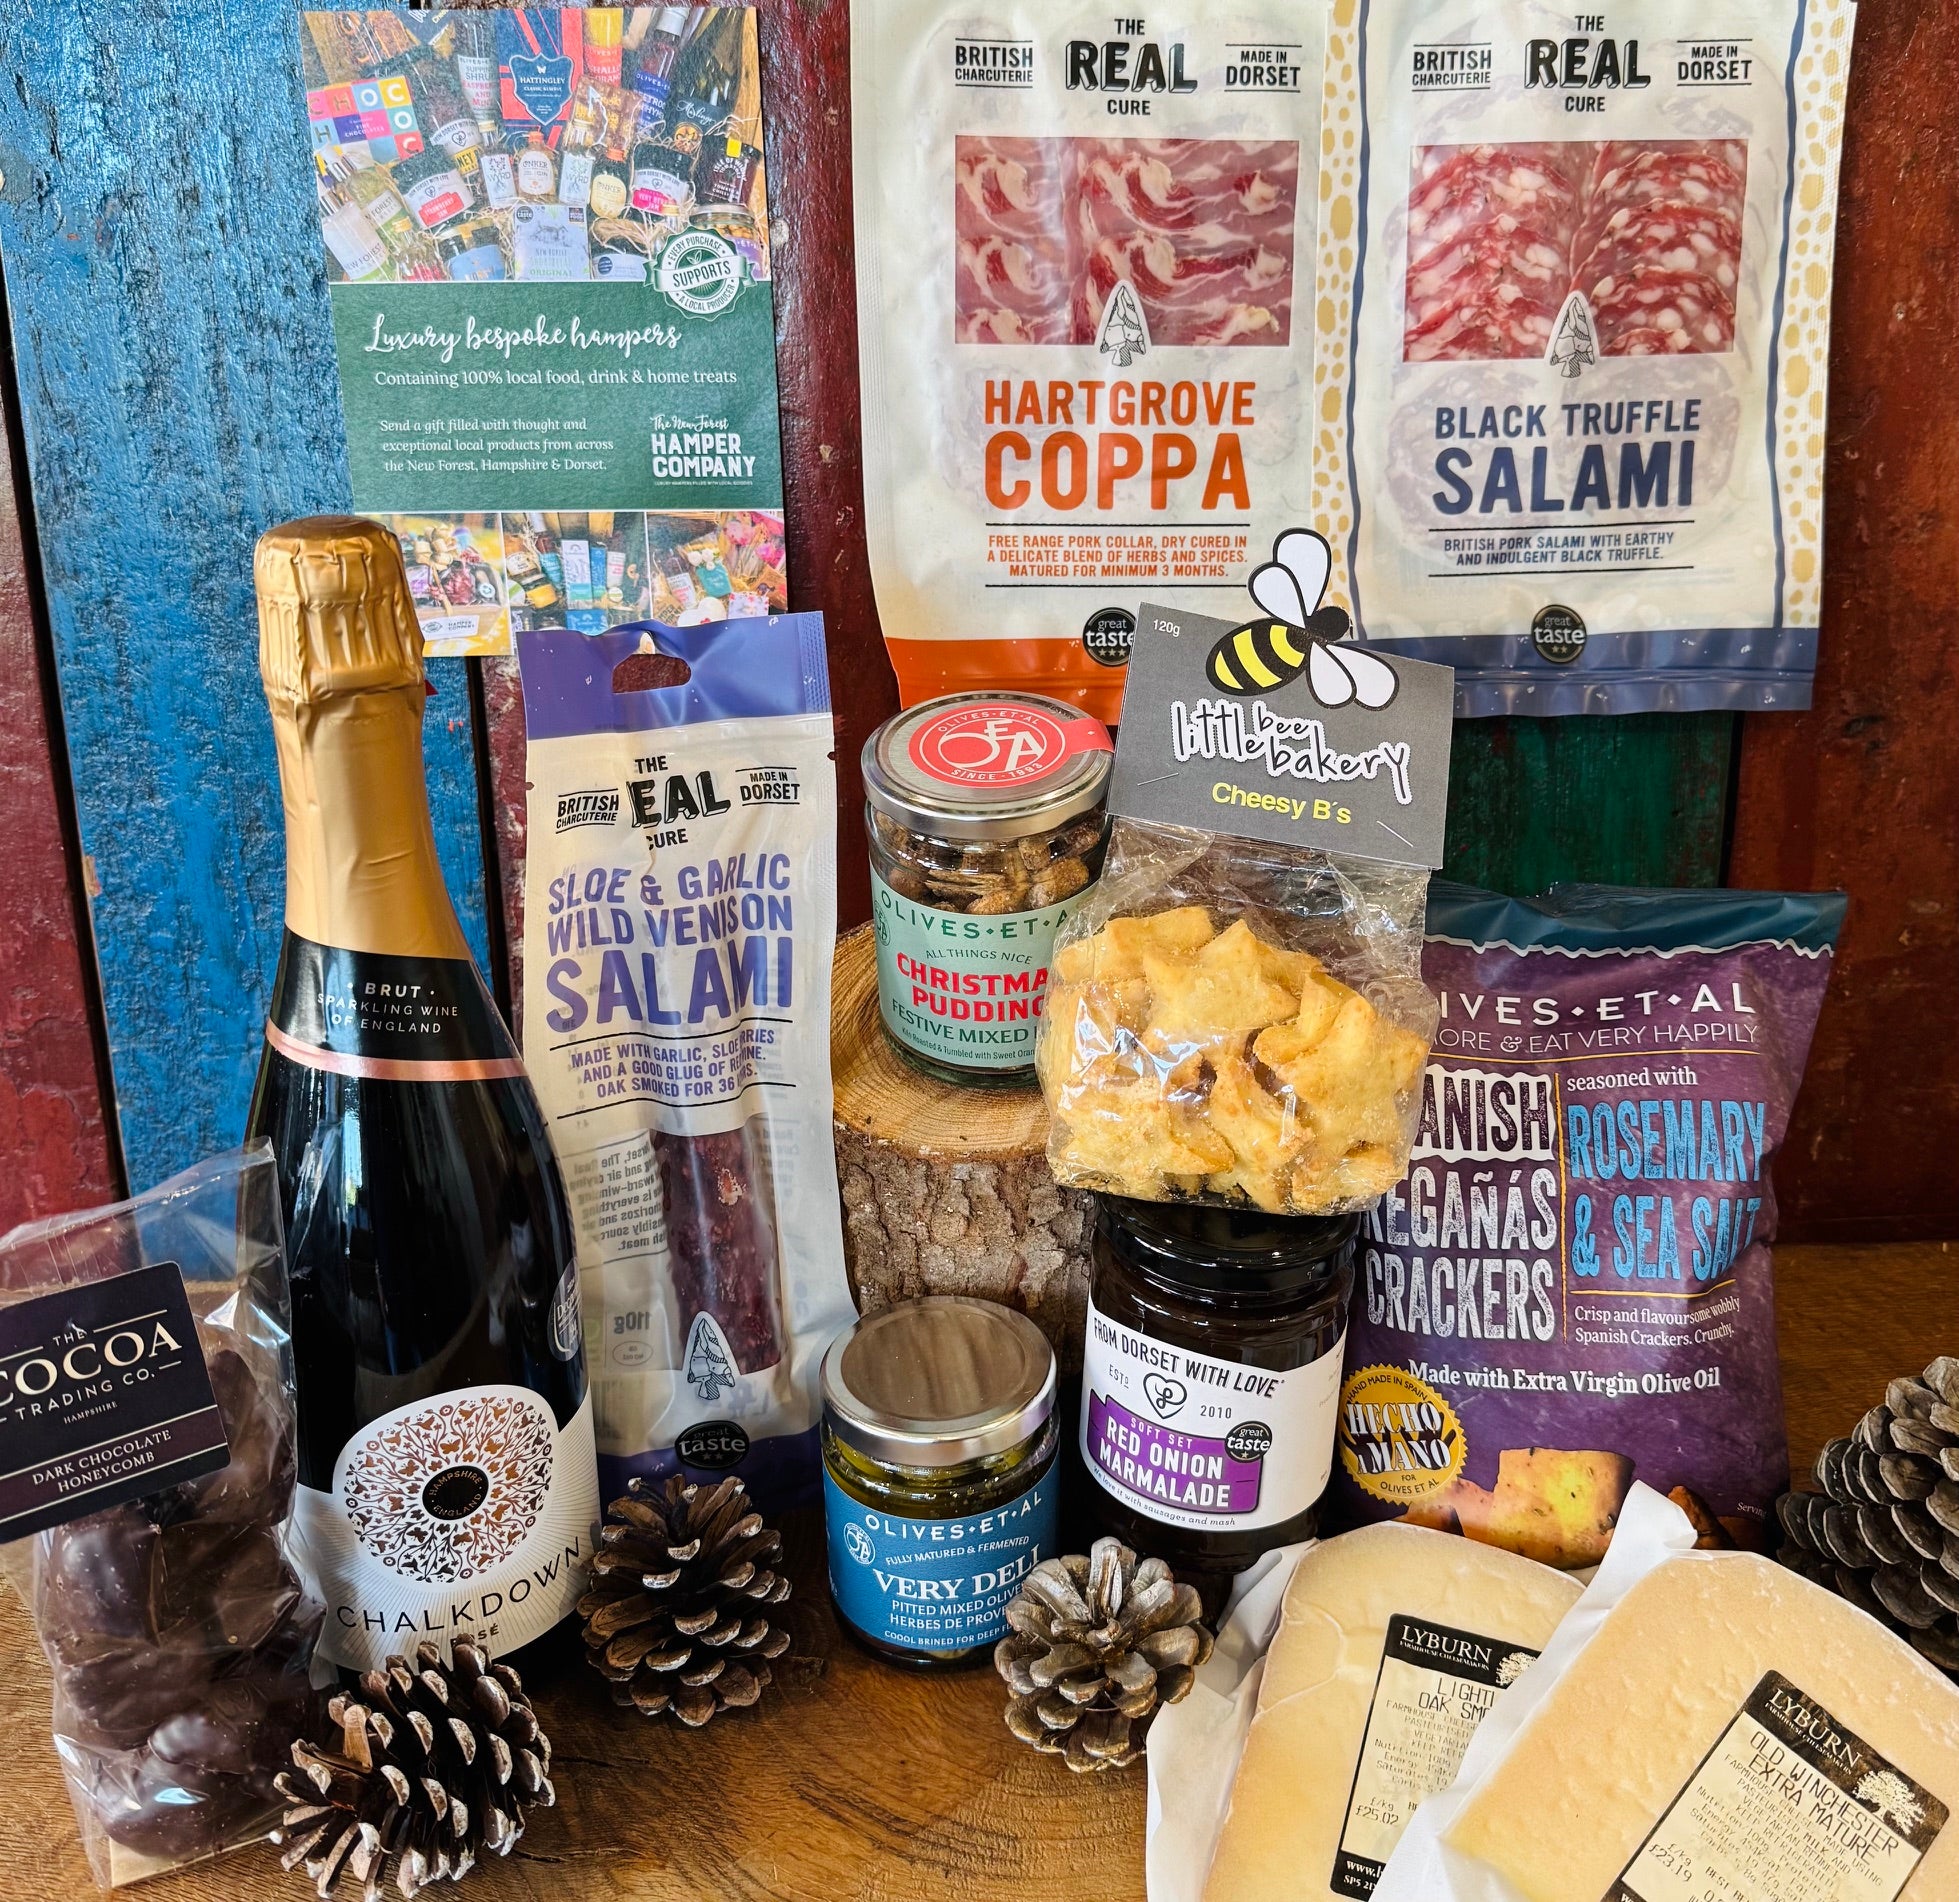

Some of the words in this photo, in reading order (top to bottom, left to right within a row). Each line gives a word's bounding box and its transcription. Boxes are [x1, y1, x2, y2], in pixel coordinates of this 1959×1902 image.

[1114, 19, 1145, 35] THE
[1575, 16, 1604, 31] THE
[956, 46, 1032, 68] BRITISH
[1240, 51, 1272, 63] MADE
[1414, 51, 1491, 71] BRITISH
[1524, 39, 1651, 89] REAL
[1691, 47, 1723, 59] MADE
[955, 68, 1032, 82] CHARCUTERIE
[1065, 41, 1198, 94] REAL
[1225, 66, 1301, 86] DORSET
[1678, 61, 1752, 80] DORSET
[1412, 72, 1491, 86] CHARCUTERIE
[1107, 100, 1151, 116] CURE
[1565, 97, 1606, 112] CURE
[672, 261, 731, 288] SUPPORTS
[685, 299, 705, 311] LOCAL
[707, 284, 735, 310] PRODUCER
[365, 313, 462, 363] Luxury
[467, 314, 566, 359] bespoke
[571, 315, 681, 357] hampers
[375, 371, 459, 388] Containing
[462, 371, 503, 385] 100%
[507, 370, 541, 384] local
[546, 370, 584, 385] food,
[589, 369, 628, 384] drink
[648, 369, 689, 383] home
[694, 369, 736, 383] treats
[985, 380, 1256, 426] HARTGROVE
[650, 413, 671, 430] The
[1435, 404, 1546, 440] BLACK
[1562, 399, 1702, 436] TRUFFLE
[383, 440, 451, 454] exceptional
[487, 439, 540, 453] products
[651, 433, 741, 454] HAMPER
[481, 459, 548, 473] Hampshire
[652, 456, 756, 477] COMPANY
[985, 431, 1251, 510] COPPA
[1432, 440, 1695, 514] SALAMI
[989, 536, 1018, 548] FREE
[1023, 536, 1064, 548] RANGE
[1068, 536, 1101, 548] PORK
[1106, 536, 1157, 550] COLLAR,
[1162, 536, 1186, 548] DRY
[1190, 536, 1230, 548] CURED
[1444, 538, 1494, 552] BRITISH
[1500, 537, 1532, 550] PORK
[1536, 536, 1585, 549] SALAMI
[1590, 534, 1621, 548] WITH
[1626, 532, 1674, 546] EARTHY
[1000, 551, 1059, 563] DELICATE
[1064, 551, 1103, 563] BLEND
[1127, 551, 1166, 563] HERBS
[1171, 551, 1195, 562] AND
[1200, 551, 1247, 562] SPICES.
[1457, 554, 1482, 566] AND
[1486, 551, 1556, 564] INDULGENT
[1561, 550, 1602, 562] BLACK
[1608, 548, 1664, 561] TRUFFLE.
[1009, 565, 1068, 577] MATURED
[1073, 565, 1096, 577] FOR
[1101, 565, 1157, 577] MINIMUM
[1174, 565, 1229, 577] MONTHS.
[1098, 619, 1127, 631] great
[1153, 619, 1180, 637] 120g
[1545, 617, 1571, 628] great
[1534, 627, 1585, 644] taste
[1257, 705, 1309, 733] bee
[635, 756, 668, 774] THE
[1270, 725, 1407, 799] bakery
[750, 772, 776, 782] MADE
[951, 768, 996, 780] SINCE
[740, 783, 800, 802] DORSET
[1212, 782, 1307, 821] Cheesy
[557, 794, 620, 818] BRITISH
[556, 812, 617, 828] CHARCUTERIE
[548, 868, 631, 915] SLOE
[677, 853, 791, 900] GARLIC
[547, 908, 635, 956] WILD
[644, 894, 793, 947] VENISON
[1001, 952, 1033, 965] NICE
[546, 936, 793, 1033] SALAMI
[318, 993, 413, 1016] SPARKLING
[421, 1006, 458, 1017] WINE
[361, 1019, 441, 1034] ENGLAND
[892, 999, 954, 1039] FESTIVE
[959, 1028, 1028, 1044] MIXED
[1577, 1025, 1647, 1049] VERY
[1654, 1022, 1758, 1045] HAPPILY
[596, 1077, 626, 1098] OAK
[632, 1077, 679, 1097] SMOKED
[685, 1082, 713, 1096] FOR
[1567, 1068, 1650, 1092] seasoned
[1653, 1066, 1698, 1087] with
[1568, 1099, 1765, 1183] ROSEMARY
[1612, 1194, 1681, 1280] SEA
[1366, 1248, 1555, 1343] CRACKERS
[1575, 1305, 1612, 1326] Crisp
[1575, 1328, 1628, 1346] Spanish
[1094, 1317, 1118, 1350] FROM
[1122, 1334, 1180, 1374] DORSET
[1185, 1358, 1230, 1388] WITH
[1408, 1359, 1461, 1387] Made
[1463, 1367, 1510, 1390] with
[1513, 1369, 1567, 1392] Extra
[1575, 1371, 1638, 1398] Virgin
[1641, 1369, 1691, 1393] Olive
[1694, 1366, 1721, 1389] Oil
[15, 1380, 114, 1422] TRADING
[1200, 1405, 1232, 1419] 2010
[63, 1400, 118, 1425] HAMPSHIRE
[1346, 1401, 1442, 1435] HECHO
[679, 1437, 746, 1456] taste
[1107, 1415, 1141, 1456] RED
[1149, 1443, 1223, 1480] ONION
[1227, 1436, 1271, 1452] taste
[32, 1463, 75, 1485] DARK
[79, 1428, 172, 1468] CHOCOLATE
[1366, 1439, 1451, 1473] MANO
[58, 1451, 156, 1493] HONEYCOMB
[1099, 1437, 1231, 1508] MARMALADE
[429, 1471, 482, 1496] HAMPSHIRE
[1380, 1482, 1412, 1493] OLIVES
[434, 1494, 481, 1517] ENGLAND
[1144, 1505, 1186, 1522] sausages
[1189, 1517, 1207, 1525] and
[1210, 1518, 1235, 1526] mash
[914, 1547, 965, 1563] MATURED
[978, 1536, 1029, 1552] FERMENTED
[336, 1536, 580, 1633] CHALKDOWN
[872, 1568, 965, 1600] VERY
[892, 1599, 937, 1616] PITTED
[939, 1600, 983, 1616] MIXED
[890, 1613, 941, 1629] HERBES
[1401, 1624, 1493, 1663] LYBURN
[1418, 1692, 1452, 1714] OAK
[1768, 1688, 1861, 1768] LYBURN
[1748, 1731, 1787, 1766] OLD
[1787, 1764, 1903, 1859] WINCHESTER
[1355, 1804, 1399, 1826] £25.02
[1748, 1756, 1806, 1805] EXTRA
[1808, 1804, 1878, 1863] MATURE
[1651, 1844, 1692, 1882] £23.19
[1705, 1866, 1729, 1889] BEST
